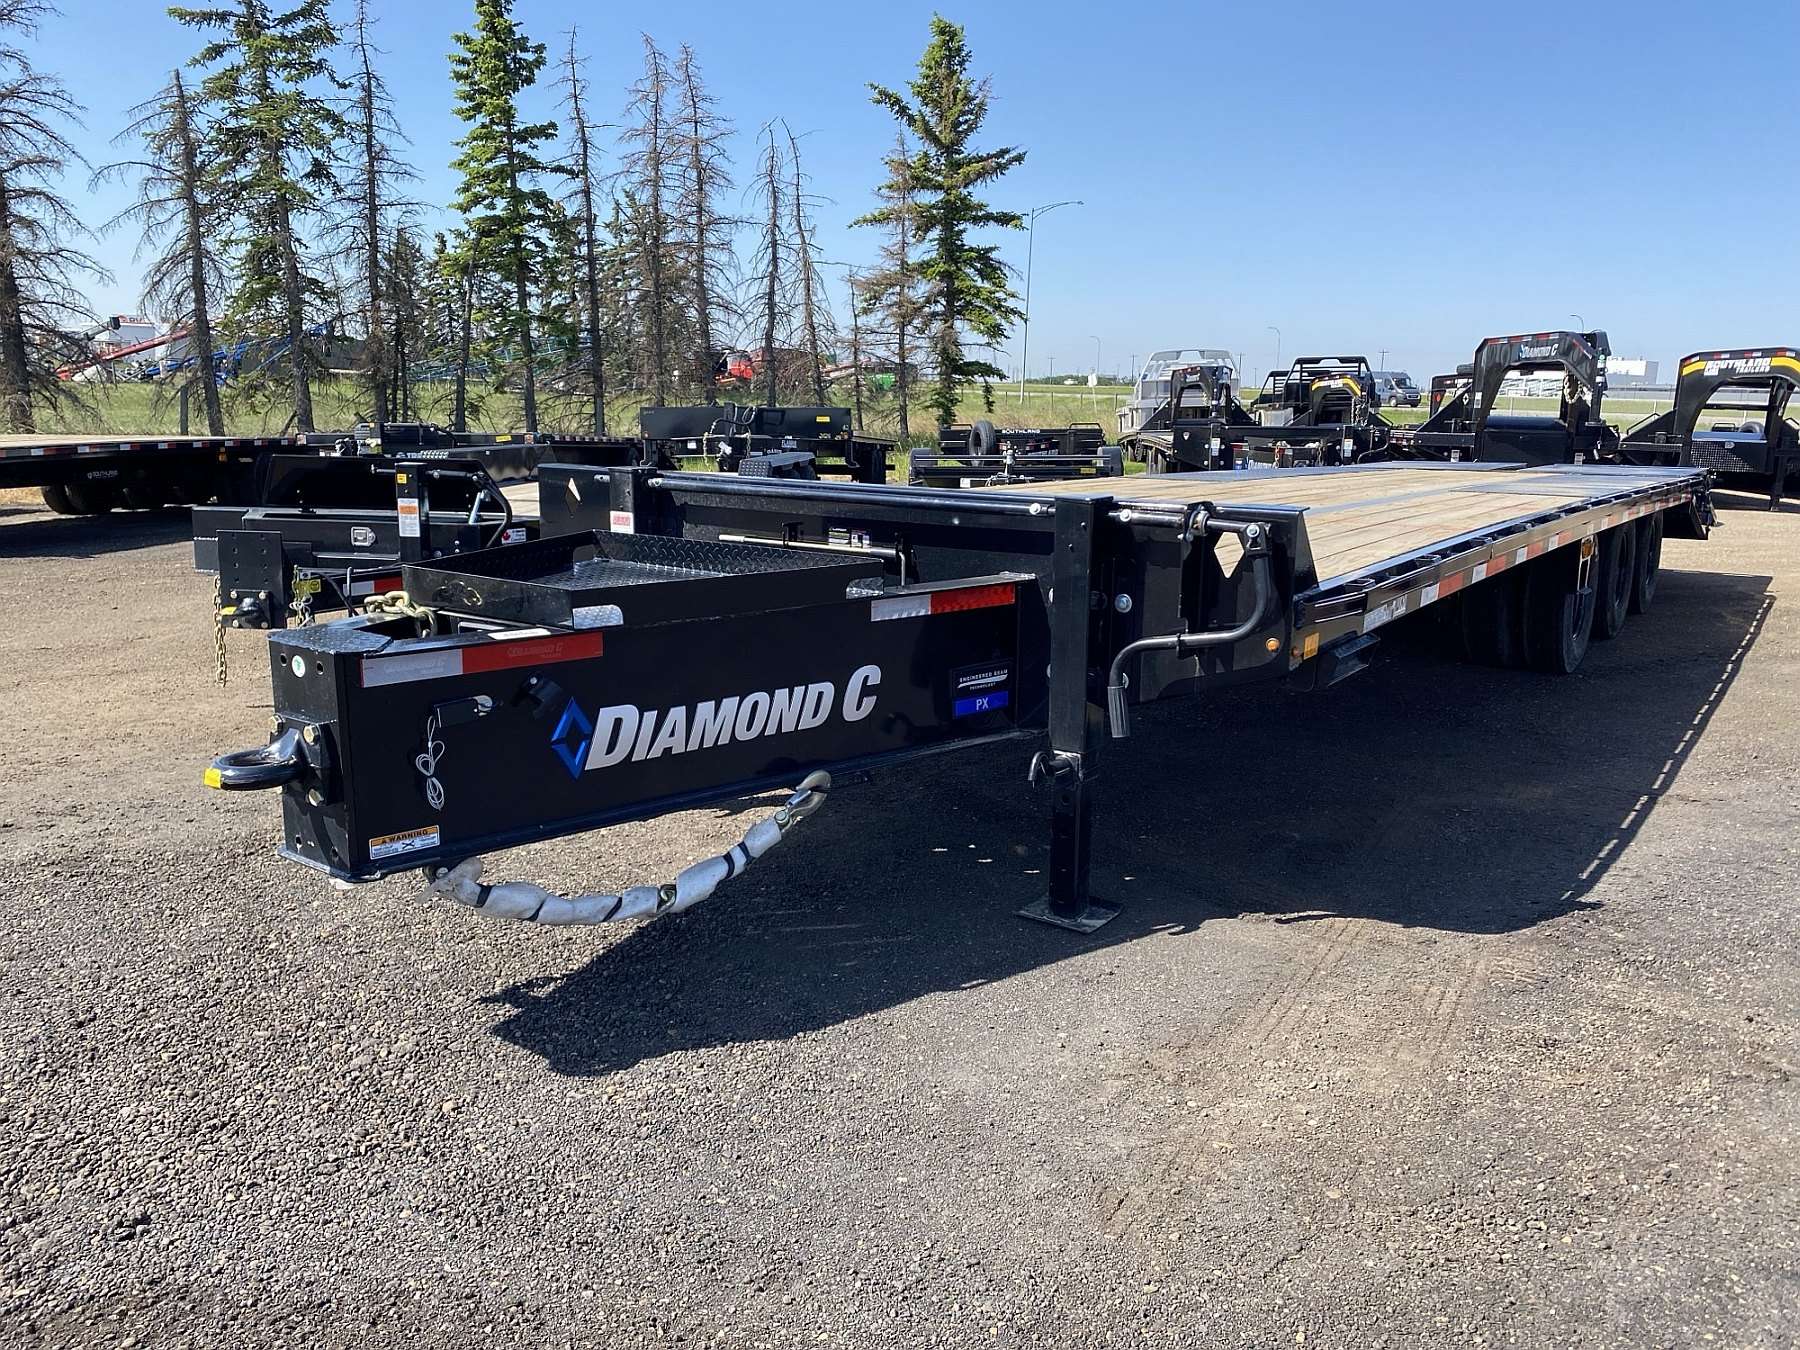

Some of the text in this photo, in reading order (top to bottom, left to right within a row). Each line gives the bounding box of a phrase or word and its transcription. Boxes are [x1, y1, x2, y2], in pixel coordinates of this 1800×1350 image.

[1551, 343, 1559, 356] C
[1704, 357, 1771, 370] SOUTHLAND
[1735, 366, 1771, 374] TRAILERS
[959, 672, 993, 682] ENGINEERED
[976, 697, 989, 710] PX
[585, 664, 881, 770] DIAMOND C
[391, 829, 428, 841] WARNING
